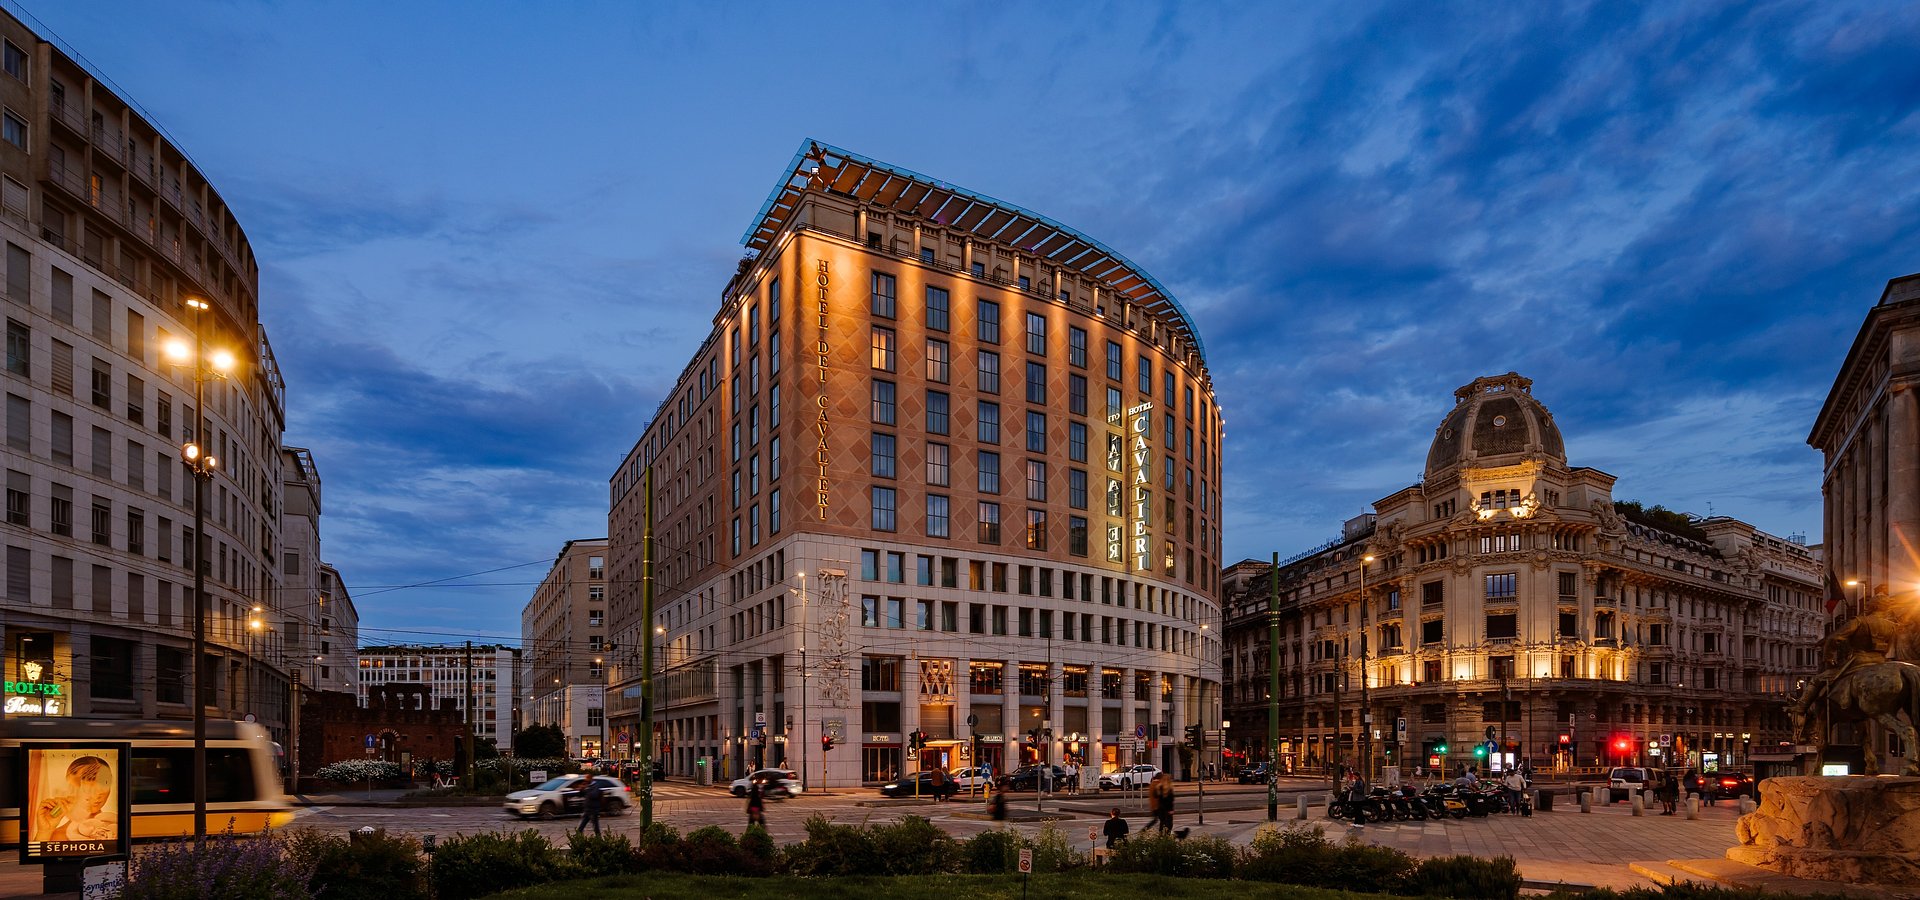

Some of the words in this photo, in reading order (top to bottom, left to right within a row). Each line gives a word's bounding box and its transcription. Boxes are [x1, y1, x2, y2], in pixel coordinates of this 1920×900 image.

[817, 259, 829, 330] HOTEL
[818, 340, 829, 382] DEI
[1128, 402, 1153, 416] HOTEL
[817, 395, 829, 520] CAVALIERI
[1134, 416, 1148, 571] CAVALIERI
[46, 843, 105, 852] SEPHORA
